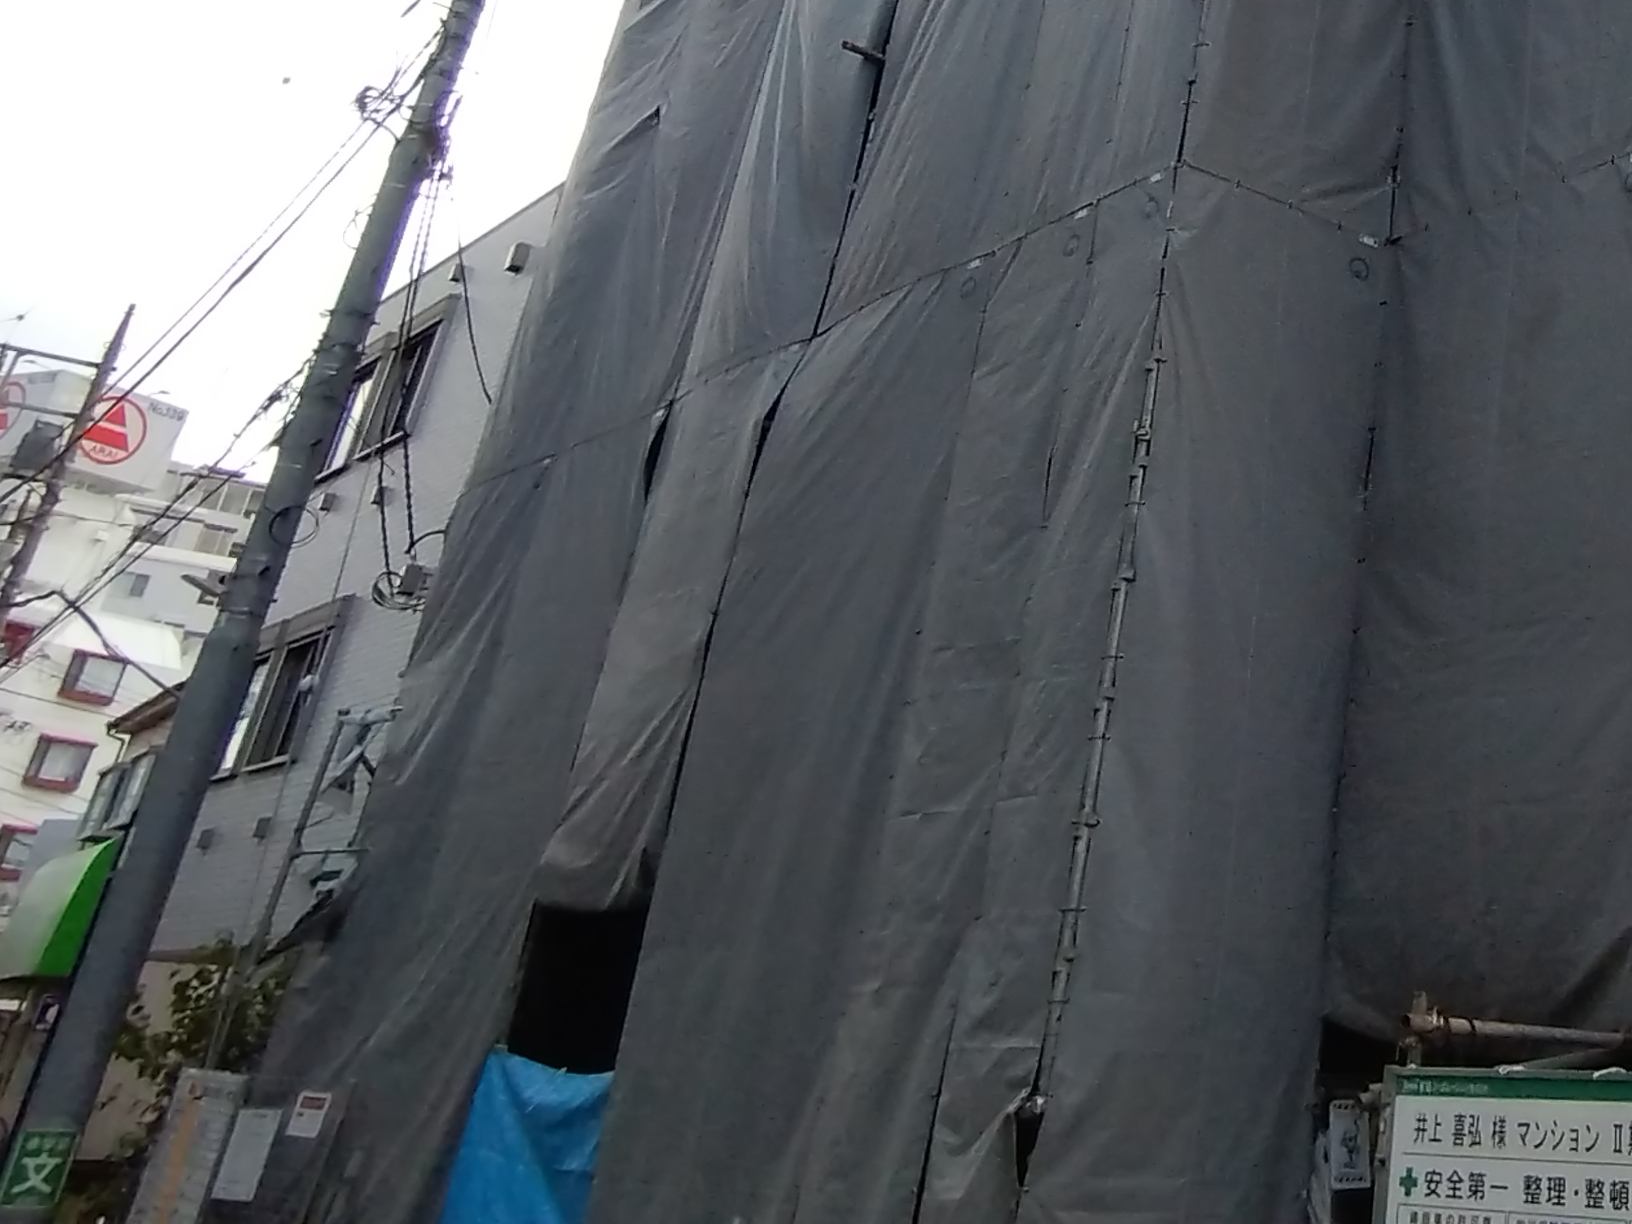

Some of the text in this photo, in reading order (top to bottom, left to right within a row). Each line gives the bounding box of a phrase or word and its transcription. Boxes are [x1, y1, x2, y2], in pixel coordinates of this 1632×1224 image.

[1412, 1112, 1443, 1145] 井上
[1451, 1113, 1483, 1148] 喜弘
[1491, 1114, 1508, 1150] 様
[1516, 1120, 1601, 1154] マンション
[1423, 1169, 1631, 1212] 安全第一 整理・整頓
